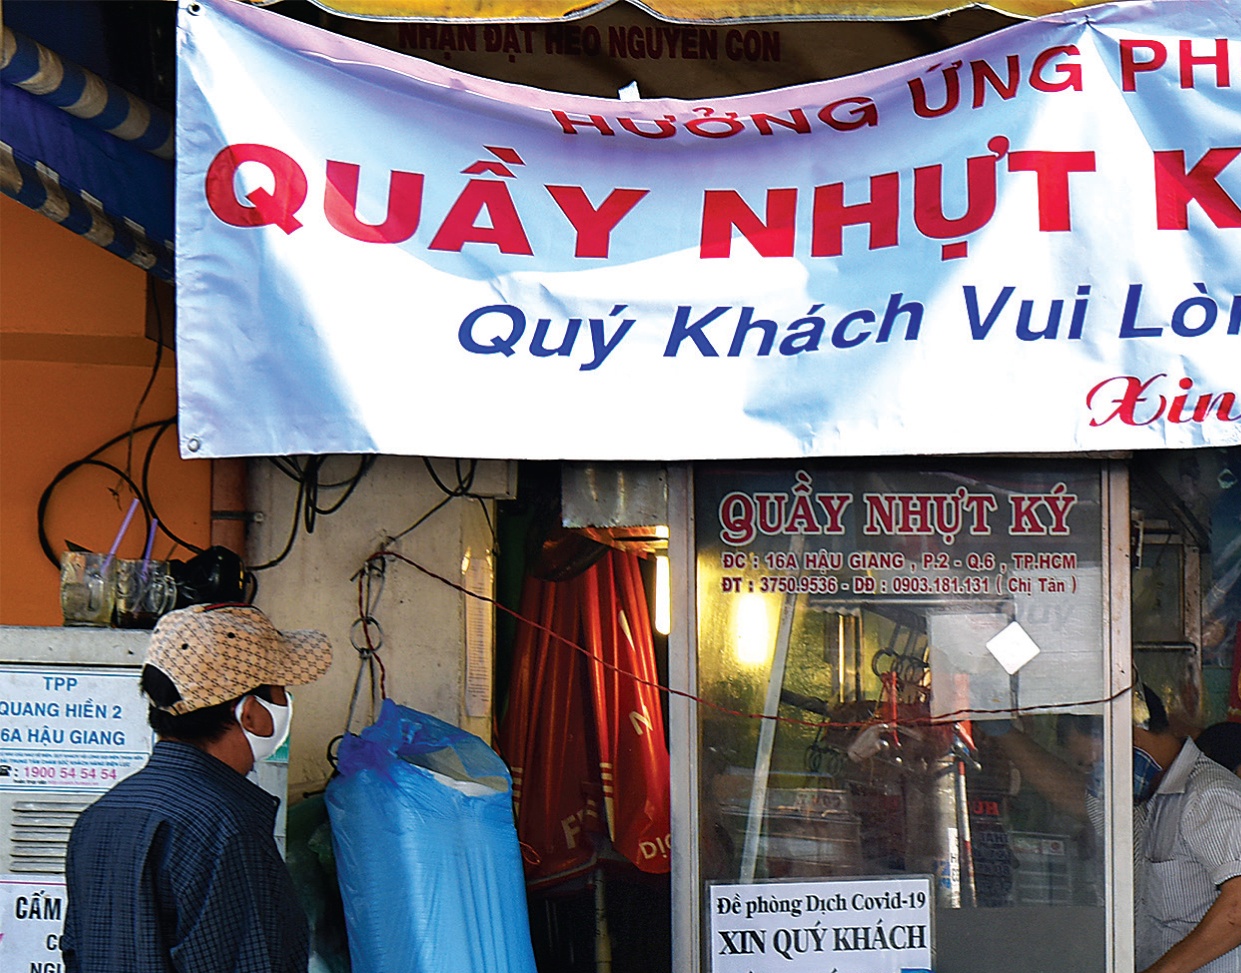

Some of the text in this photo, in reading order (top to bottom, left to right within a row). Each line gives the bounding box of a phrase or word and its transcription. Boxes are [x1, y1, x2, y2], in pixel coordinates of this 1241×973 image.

[725, 29, 780, 62] CON
[551, 98, 879, 138] HƯỞNG
[908, 44, 1084, 120] ỨNG
[204, 144, 649, 259] QUẦY
[699, 136, 1096, 260] NHỰT
[457, 304, 636, 372] Quý
[663, 293, 925, 359] Khách
[962, 284, 1091, 342] Vui
[719, 470, 1077, 546] QUẦY NHỰT KÝ
[722, 552, 747, 570] ĐC
[766, 552, 800, 570] 16A
[805, 548, 842, 575] HẬU
[848, 552, 904, 570] GIANG
[922, 552, 948, 570] P.2
[967, 552, 995, 571] Q.6
[1013, 552, 1076, 570] TP.HCM
[722, 578, 743, 593] ĐT
[760, 577, 836, 594] 3750.9536
[892, 577, 989, 594] 0903.181.131
[1007, 577, 1032, 596] Chị
[43, 677, 78, 691] TPP
[0, 698, 122, 719] QUANG HIỀN 2
[27, 725, 64, 746] HẬU
[69, 730, 125, 746] GIANG
[24, 766, 55, 779] 1900
[60, 767, 76, 779] 54
[80, 768, 96, 780] 54
[101, 768, 117, 780] 54
[15, 890, 62, 921] CẤM
[717, 891, 926, 918] Đề phòng Dịch Covid-19
[718, 919, 927, 960] XIN QUÝ KHÁCH
